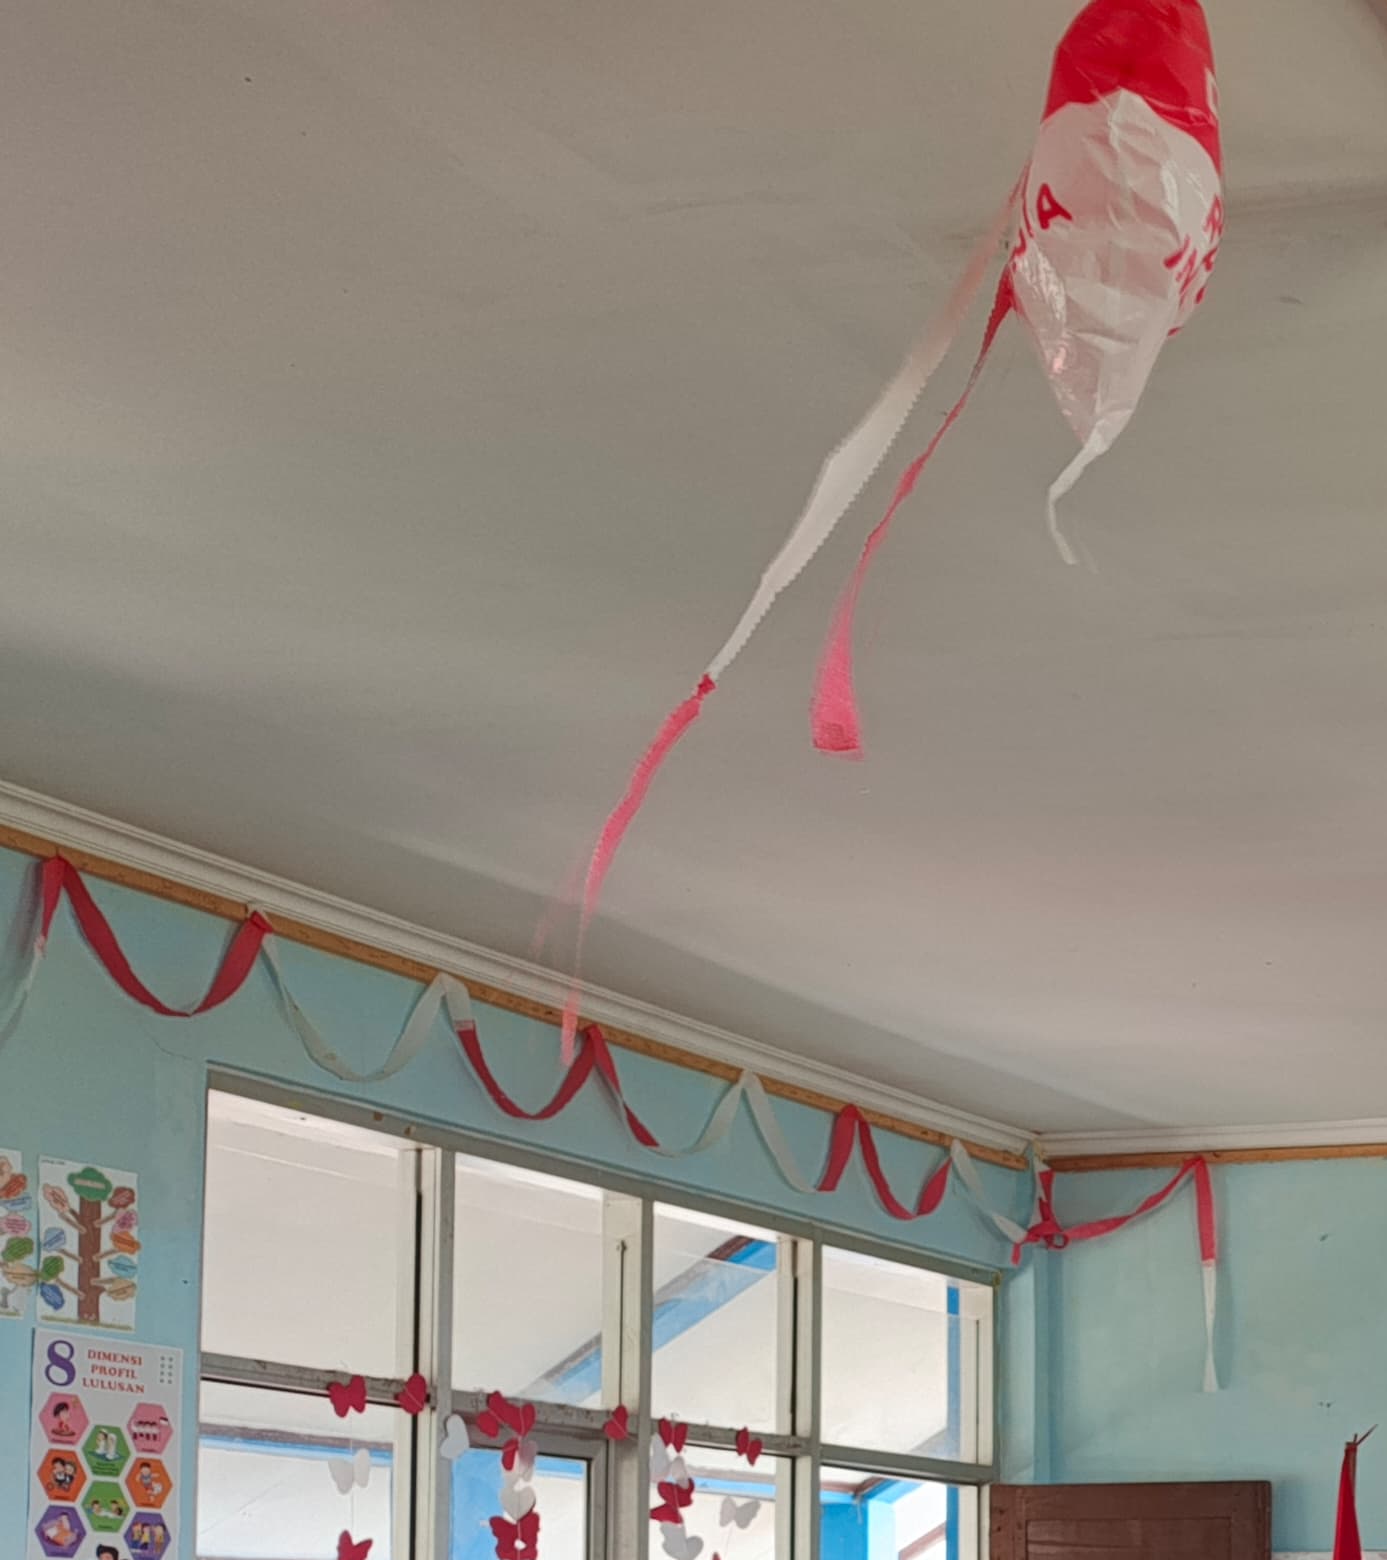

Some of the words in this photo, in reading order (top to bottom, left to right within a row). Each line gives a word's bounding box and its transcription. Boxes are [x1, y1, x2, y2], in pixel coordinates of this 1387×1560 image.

[44, 1339, 76, 1387] 8
[87, 1349, 143, 1366] DIMENSI
[91, 1363, 137, 1380] PROFIL
[82, 1377, 145, 1394] LULUSAN
